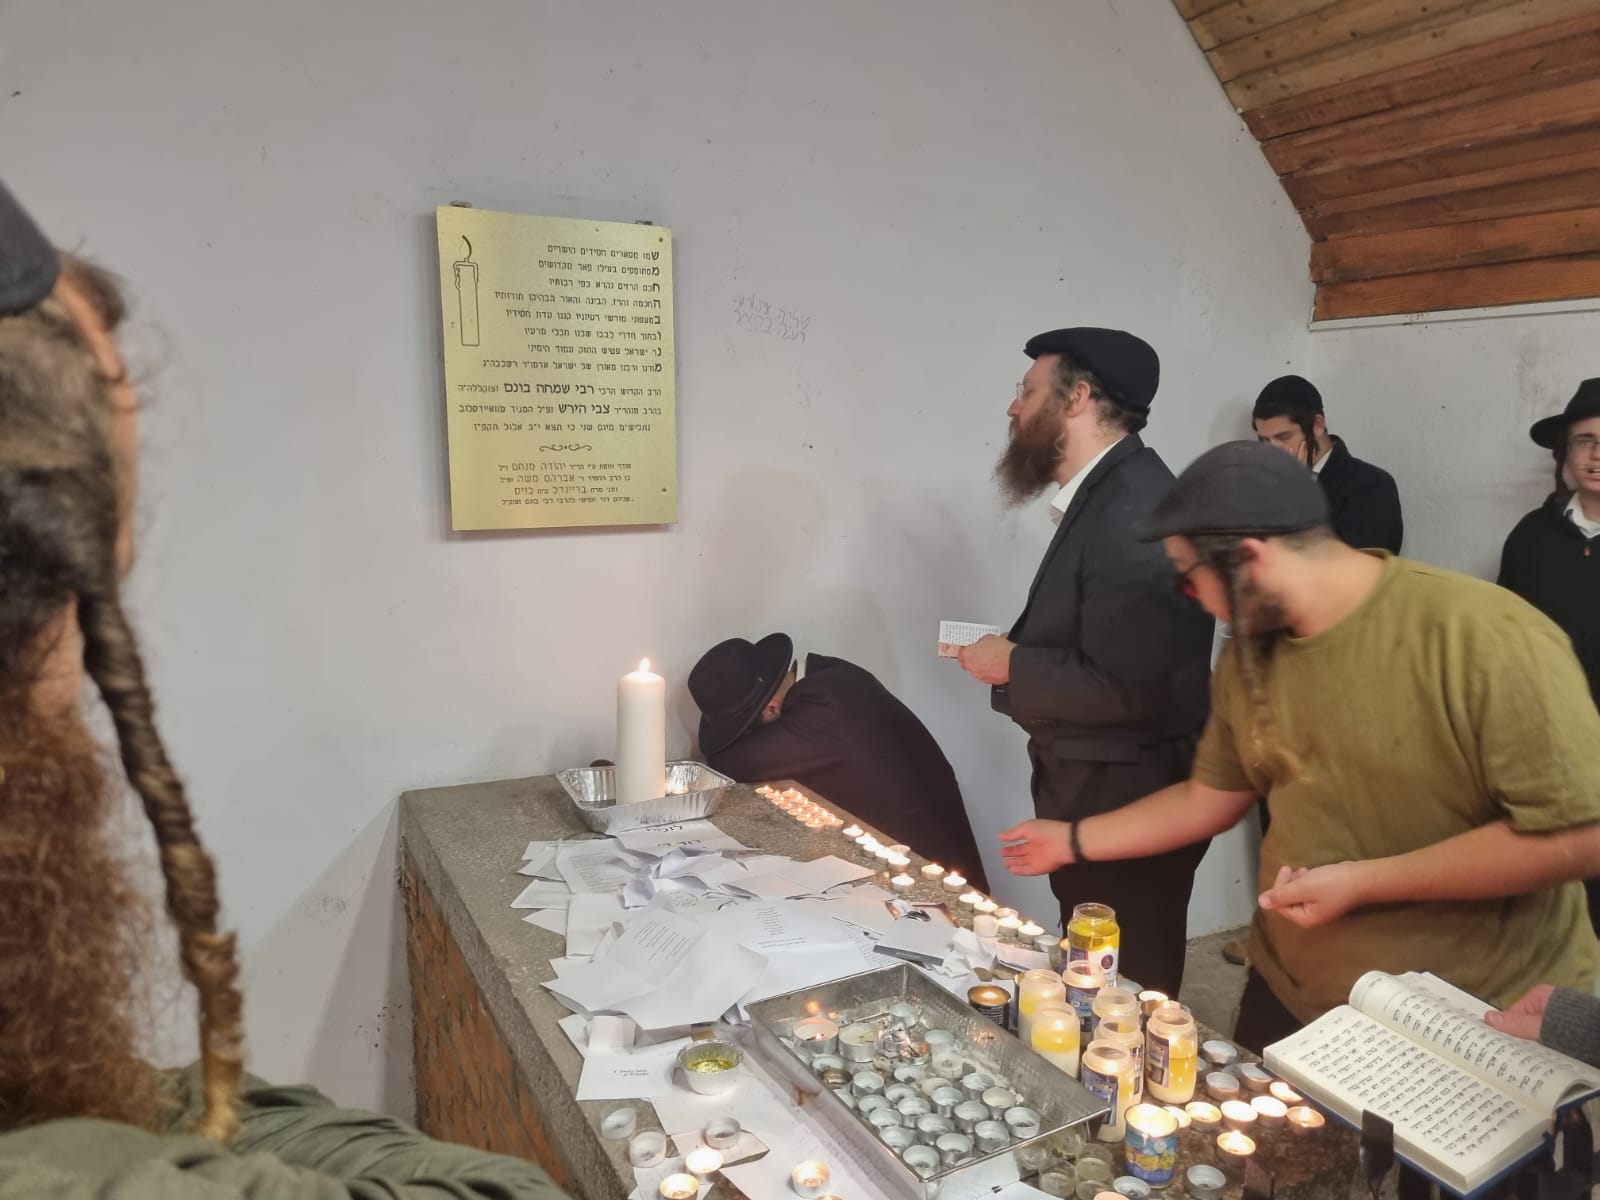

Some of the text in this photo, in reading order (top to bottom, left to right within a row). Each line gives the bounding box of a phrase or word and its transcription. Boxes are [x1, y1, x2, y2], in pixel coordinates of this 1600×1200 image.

[548, 244, 576, 254] הישרים
[581, 247, 606, 256] חסידים
[596, 280, 613, 290] נקרא
[618, 282, 638, 291] הרזים
[643, 282, 660, 292] חכם
[585, 296, 606, 306] הבינה
[633, 298, 660, 309] החכמה
[555, 345, 573, 353] עמוד
[624, 347, 648, 356] ישראל
[553, 360, 576, 369] ישראל
[581, 362, 591, 370] של
[504, 382, 530, 393] בונם
[536, 383, 570, 394] שמחה
[575, 384, 594, 394] רבי
[620, 388, 643, 396] הקדוש
[648, 388, 661, 396] הרב
[558, 403, 586, 413] הירש
[591, 403, 610, 414] צבי
[504, 422, 522, 431] אלול
[545, 423, 562, 431] תצא
[567, 423, 576, 431] כי
[580, 423, 592, 431] שני
[512, 462, 536, 471] מנחם
[541, 461, 566, 471] יהודה
[517, 474, 539, 483] משה
[544, 473, 574, 483] אברהם
[552, 485, 587, 494] בריינדל
